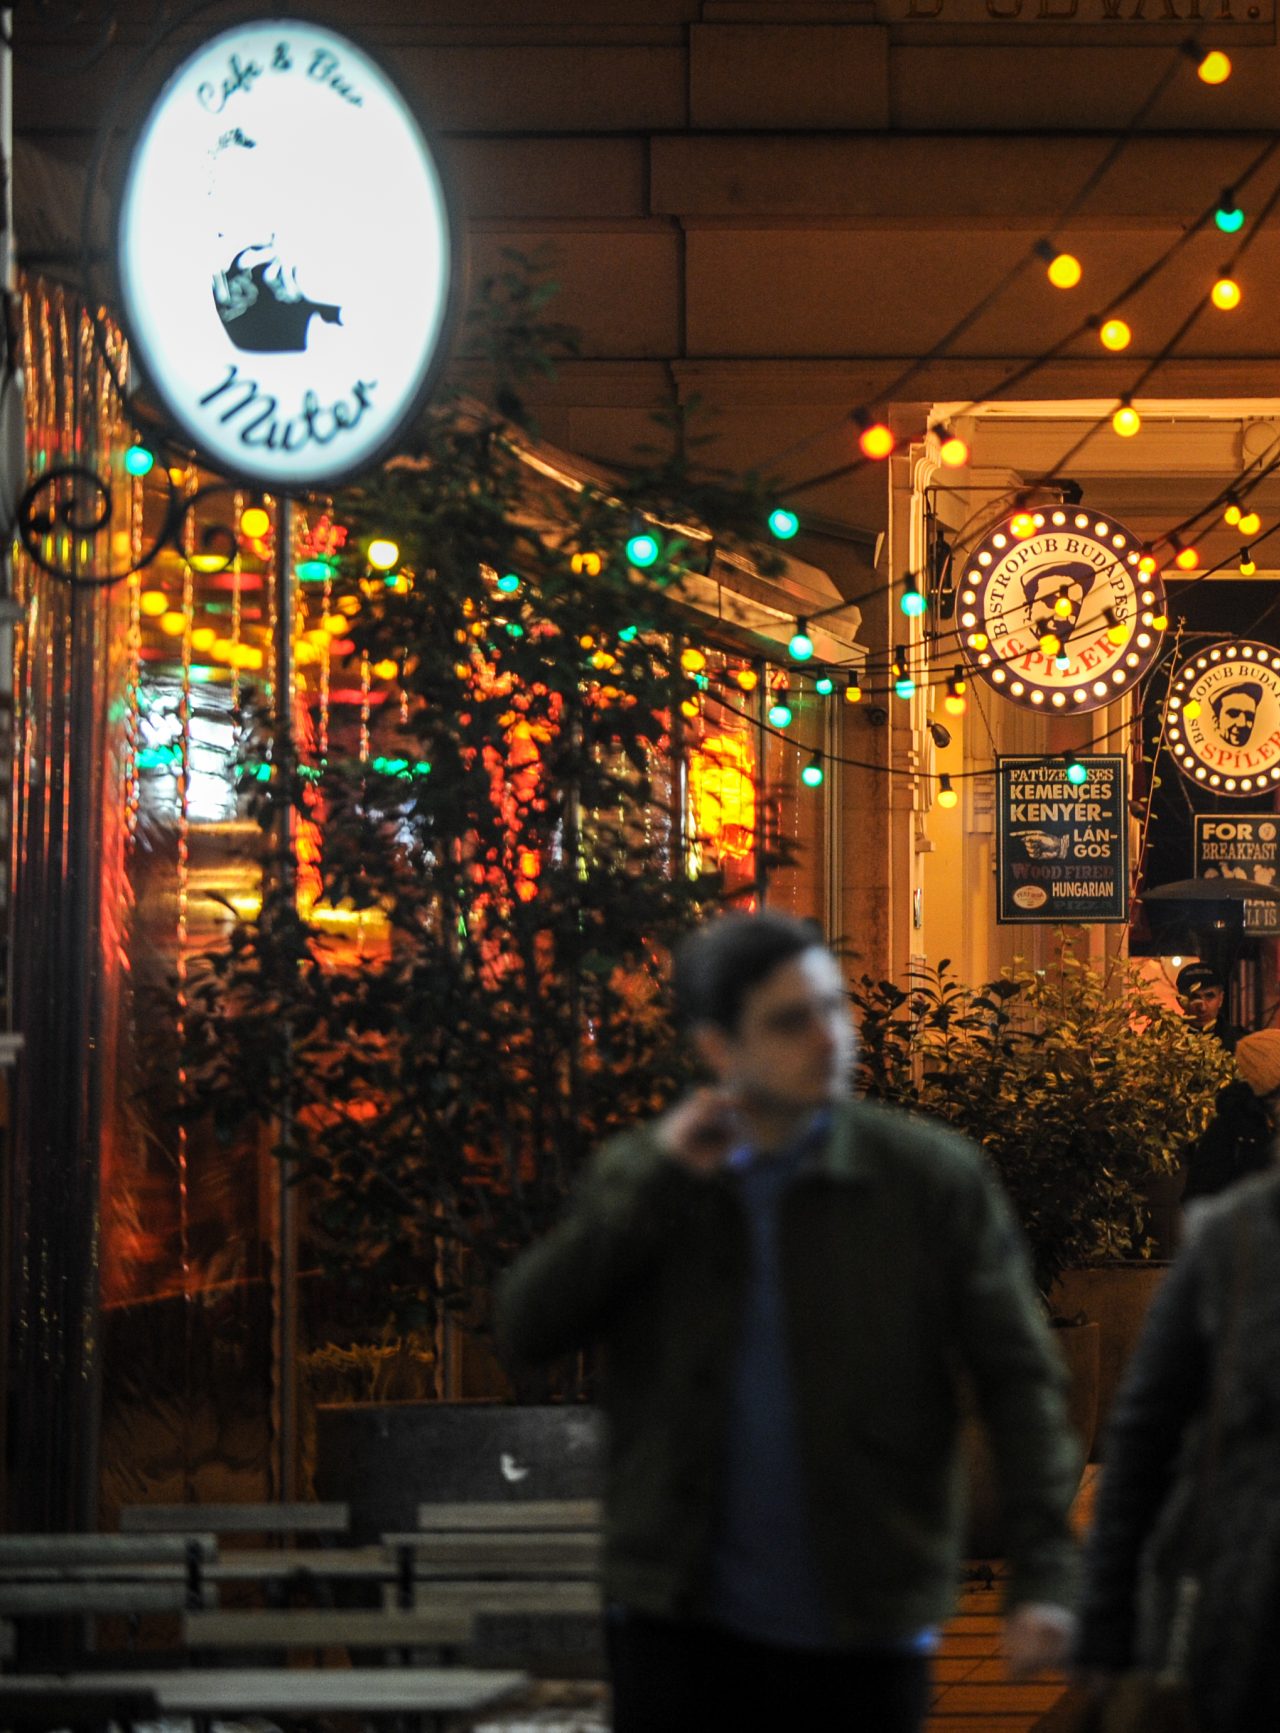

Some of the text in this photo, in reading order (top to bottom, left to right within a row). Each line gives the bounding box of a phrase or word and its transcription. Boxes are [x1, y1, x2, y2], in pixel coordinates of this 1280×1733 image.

[989, 538, 1129, 640] BISTROPUB BUDAPES
[1189, 667, 1233, 744] BISOPUB
[1010, 767, 1114, 782] FATÜZESES
[1010, 779, 1112, 800] KEMENCÉS
[1010, 798, 1113, 822] KENYÉR-
[1073, 825, 1118, 842] LÁN-
[1202, 823, 1253, 840] FOR
[1073, 844, 1111, 858] GOS
[1202, 842, 1278, 860] BREAKFAST
[1065, 863, 1114, 880] FIRED
[1052, 881, 1114, 897] HUNGARIAN
[1264, 909, 1277, 926] IS
